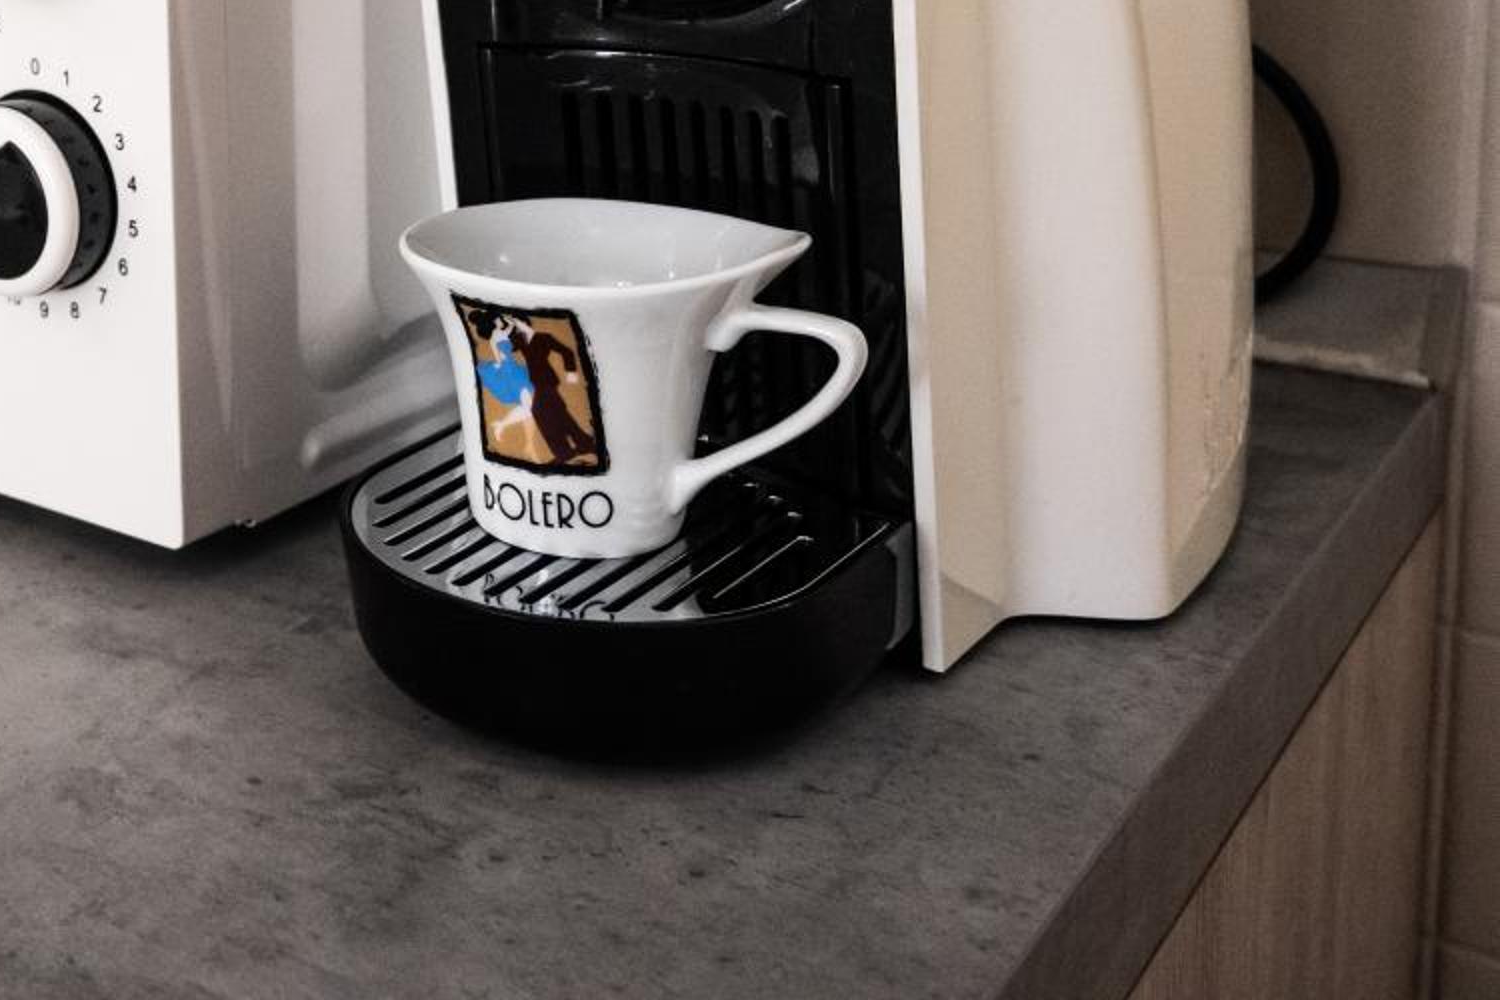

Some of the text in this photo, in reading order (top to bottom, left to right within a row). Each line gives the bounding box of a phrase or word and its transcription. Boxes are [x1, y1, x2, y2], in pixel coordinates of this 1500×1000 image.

[29, 57, 41, 76] 0
[61, 69, 70, 87] 1
[91, 94, 103, 114] 2
[114, 132, 125, 152] 3
[126, 175, 138, 193] 4
[127, 217, 140, 239] 5
[117, 257, 130, 277] 6
[97, 286, 108, 305] 7
[39, 300, 50, 319] 9
[70, 300, 81, 319] 8
[483, 473, 615, 529] BOLERO
